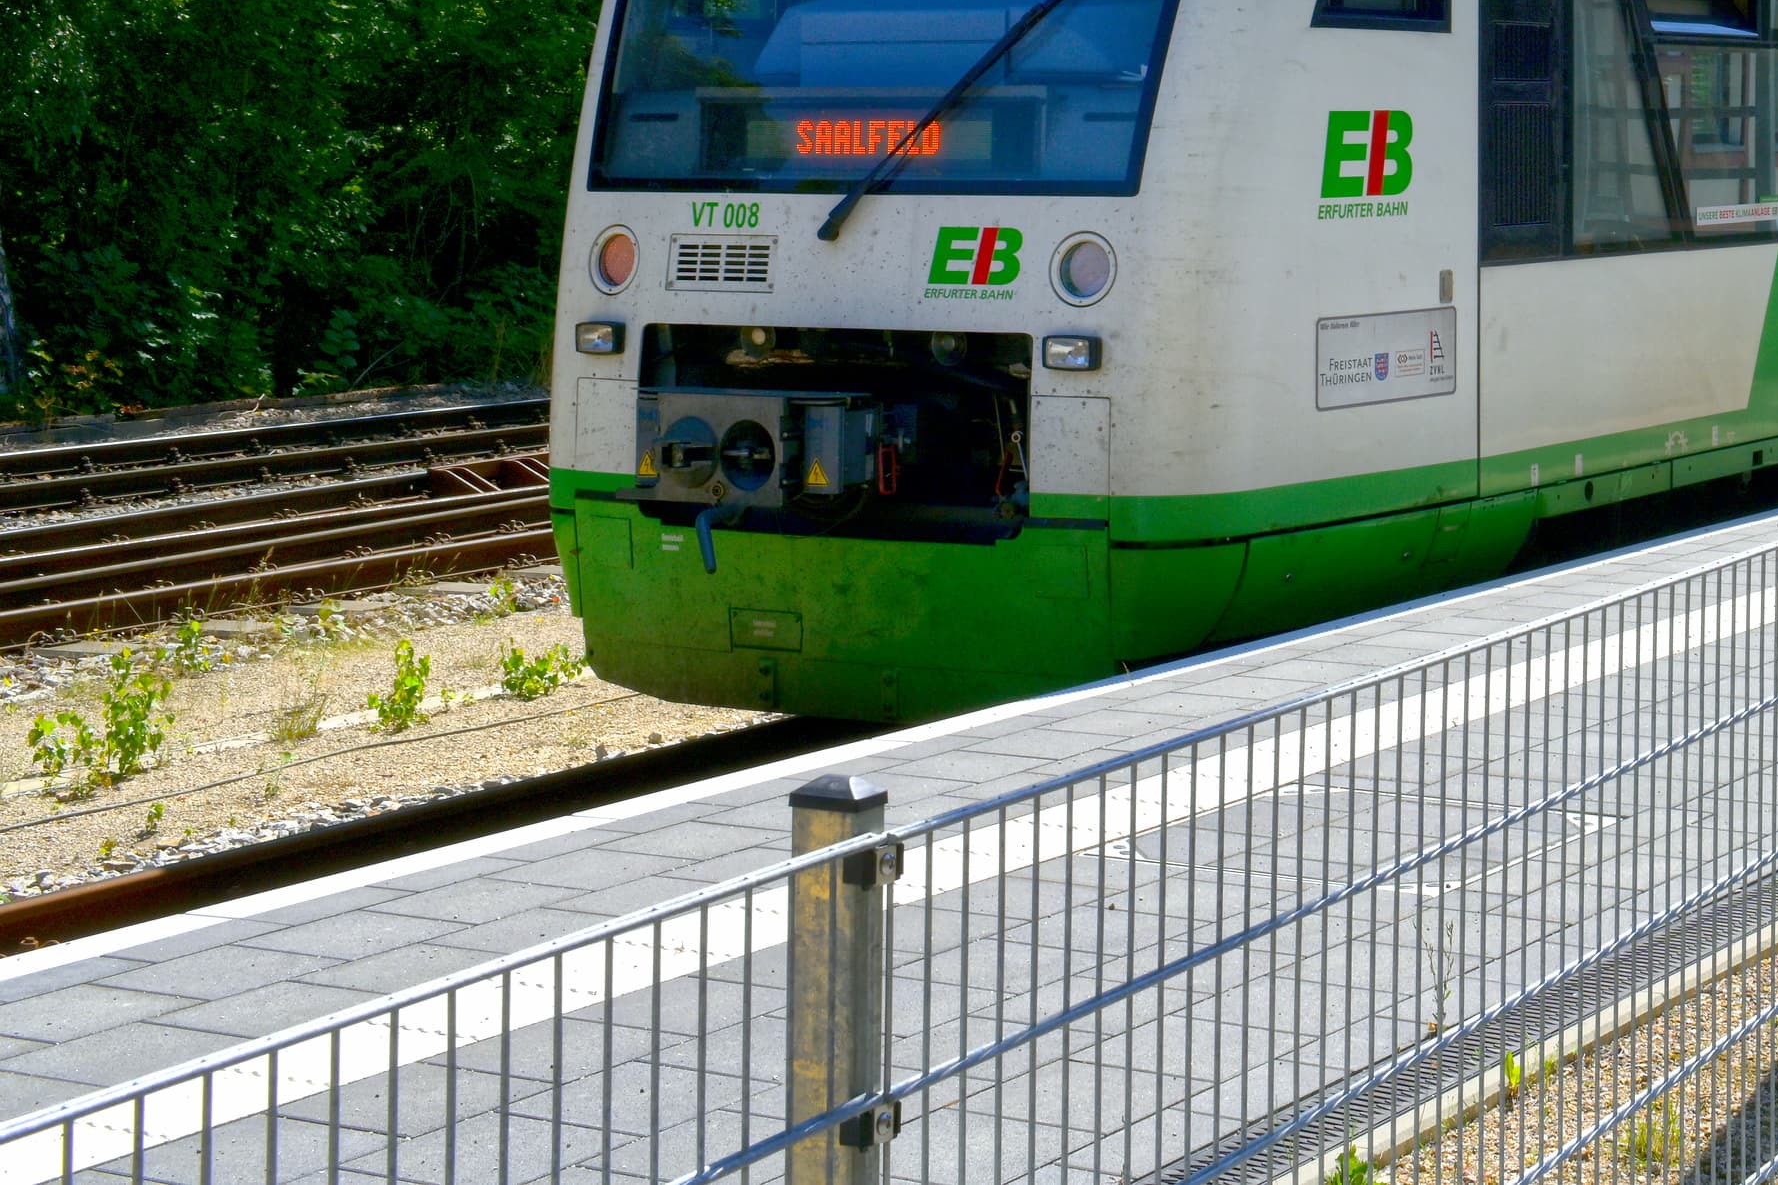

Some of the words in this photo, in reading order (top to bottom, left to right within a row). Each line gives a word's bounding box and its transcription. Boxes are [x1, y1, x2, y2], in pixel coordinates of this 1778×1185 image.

[796, 119, 941, 155] SAALFELD
[692, 201, 719, 227] VT
[723, 202, 760, 228] 008
[1317, 202, 1374, 220] ERFURTER
[1376, 201, 1409, 217] BAHN
[924, 288, 978, 299] ERFURTER
[979, 289, 1014, 300] BAHN
[1329, 357, 1373, 372] FREISTAAT
[1319, 371, 1372, 387] THÜRINGEN
